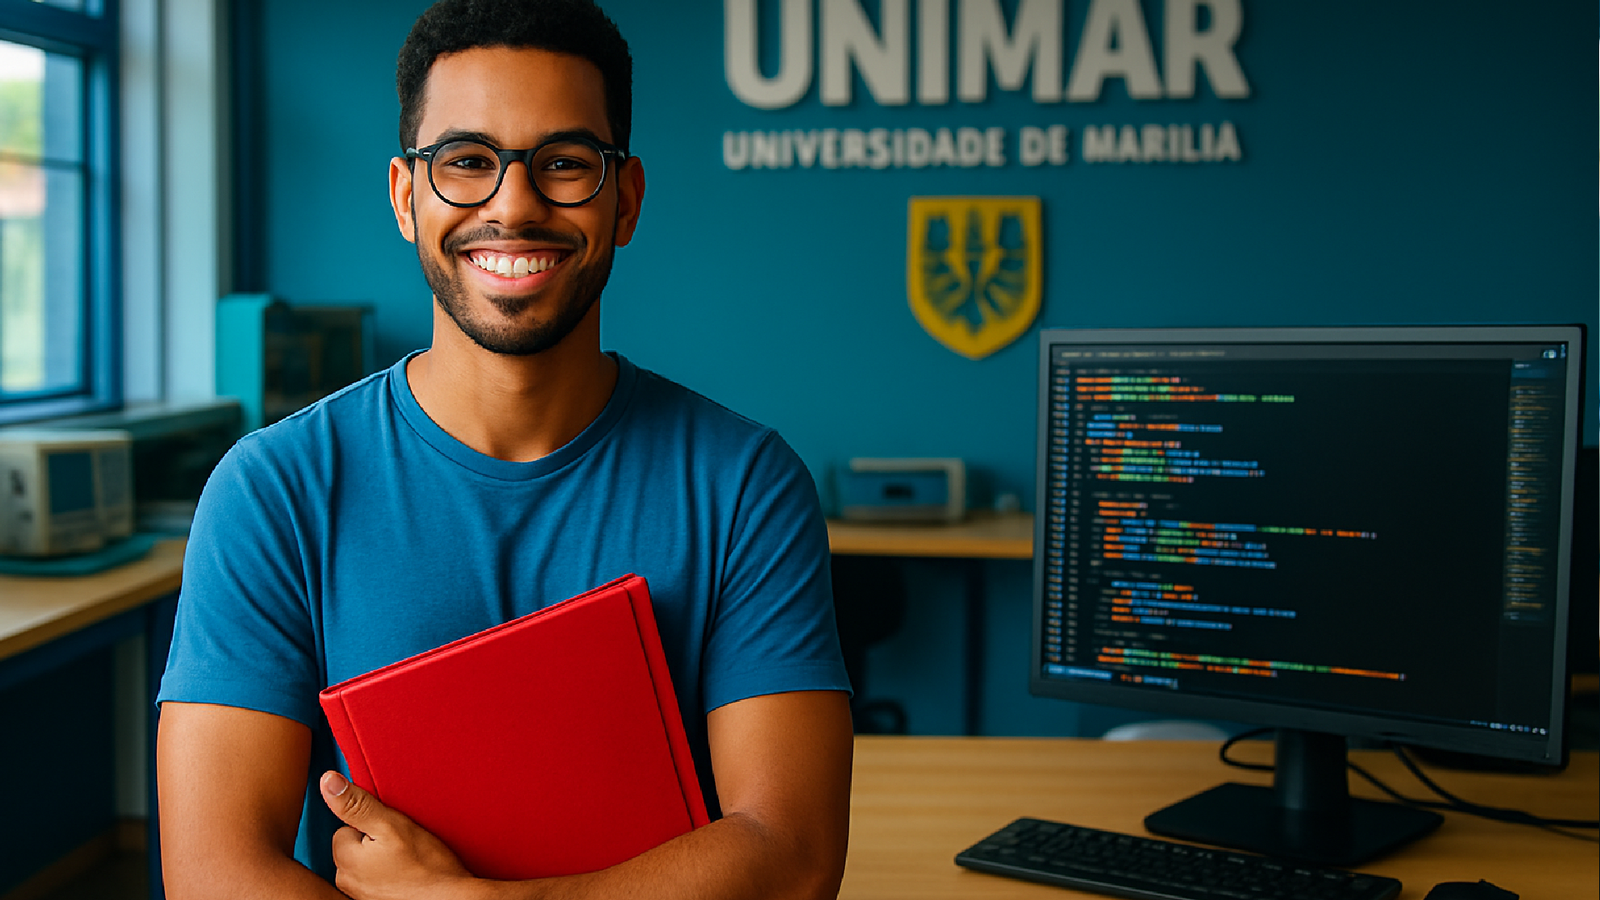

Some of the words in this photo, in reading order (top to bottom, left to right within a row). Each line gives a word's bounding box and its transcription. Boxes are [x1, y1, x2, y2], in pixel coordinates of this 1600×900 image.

[724, 0, 1248, 109] UNIMAR
[723, 128, 1004, 170] UNIVERSIDADE
[1020, 125, 1067, 167] DE
